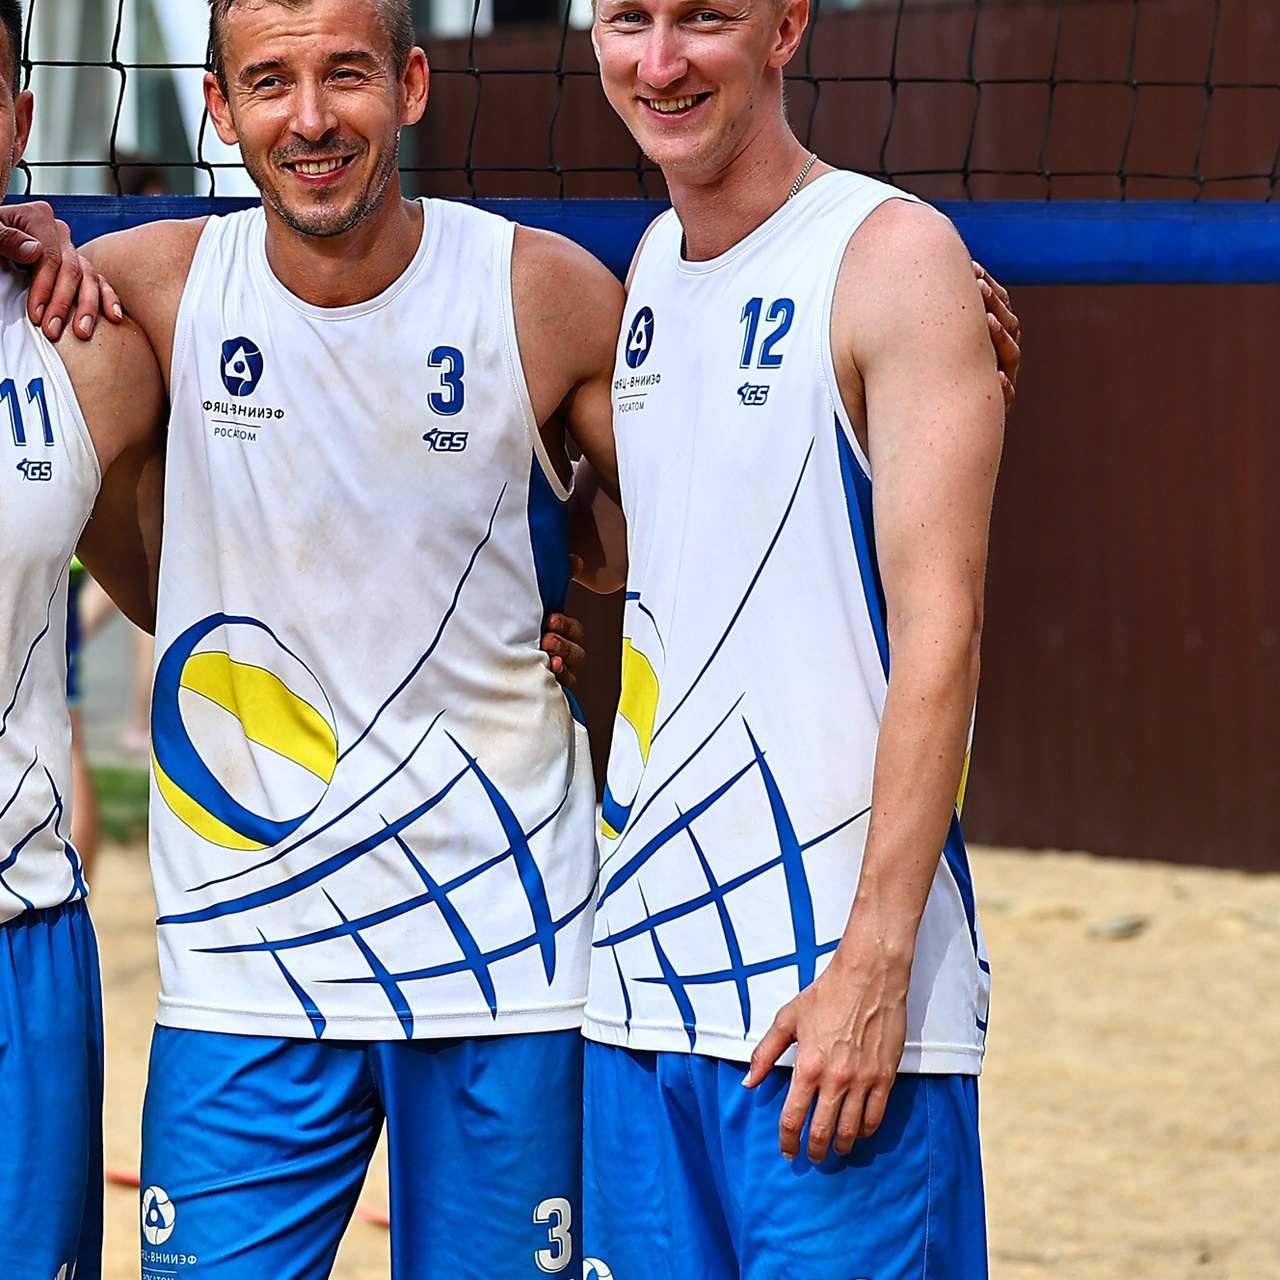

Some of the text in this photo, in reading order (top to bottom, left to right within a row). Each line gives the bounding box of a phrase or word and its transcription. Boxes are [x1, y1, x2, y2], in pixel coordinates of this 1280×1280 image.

[739, 297, 795, 370] 12
[202, 400, 285, 420] ФЯЦ-ВНИИЭФ
[427, 345, 466, 416] 3
[214, 427, 257, 442] РОСАТОМ
[533, 1197, 572, 1274] 3
